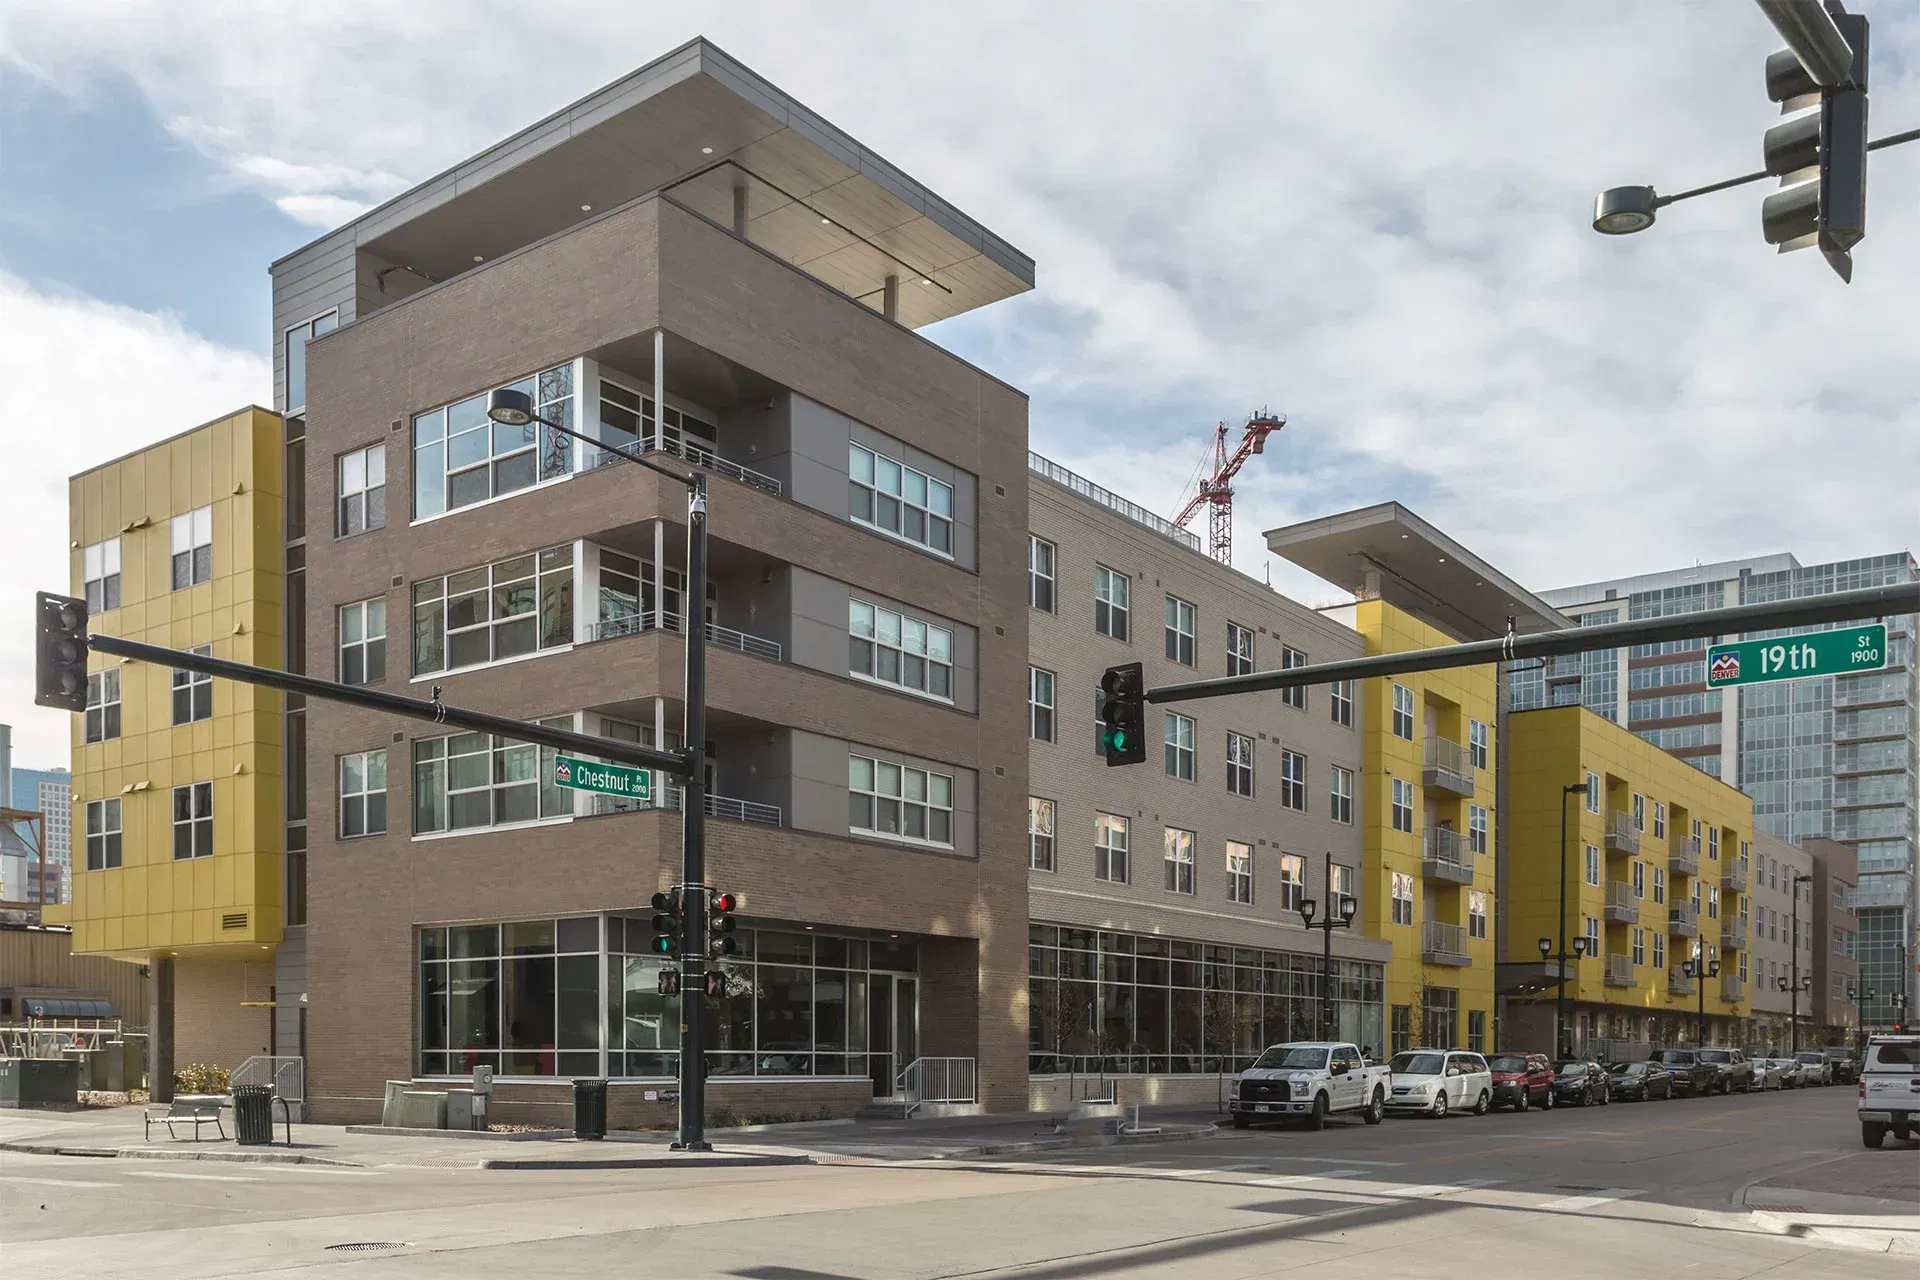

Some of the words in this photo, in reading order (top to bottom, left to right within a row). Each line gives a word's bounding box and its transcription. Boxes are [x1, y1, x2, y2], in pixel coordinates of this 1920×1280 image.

[1857, 635, 1871, 648] St
[1760, 643, 1816, 674] 19th
[1851, 649, 1878, 663] 1900
[1711, 669, 1740, 680] DENVER
[577, 766, 630, 792] Chestnut
